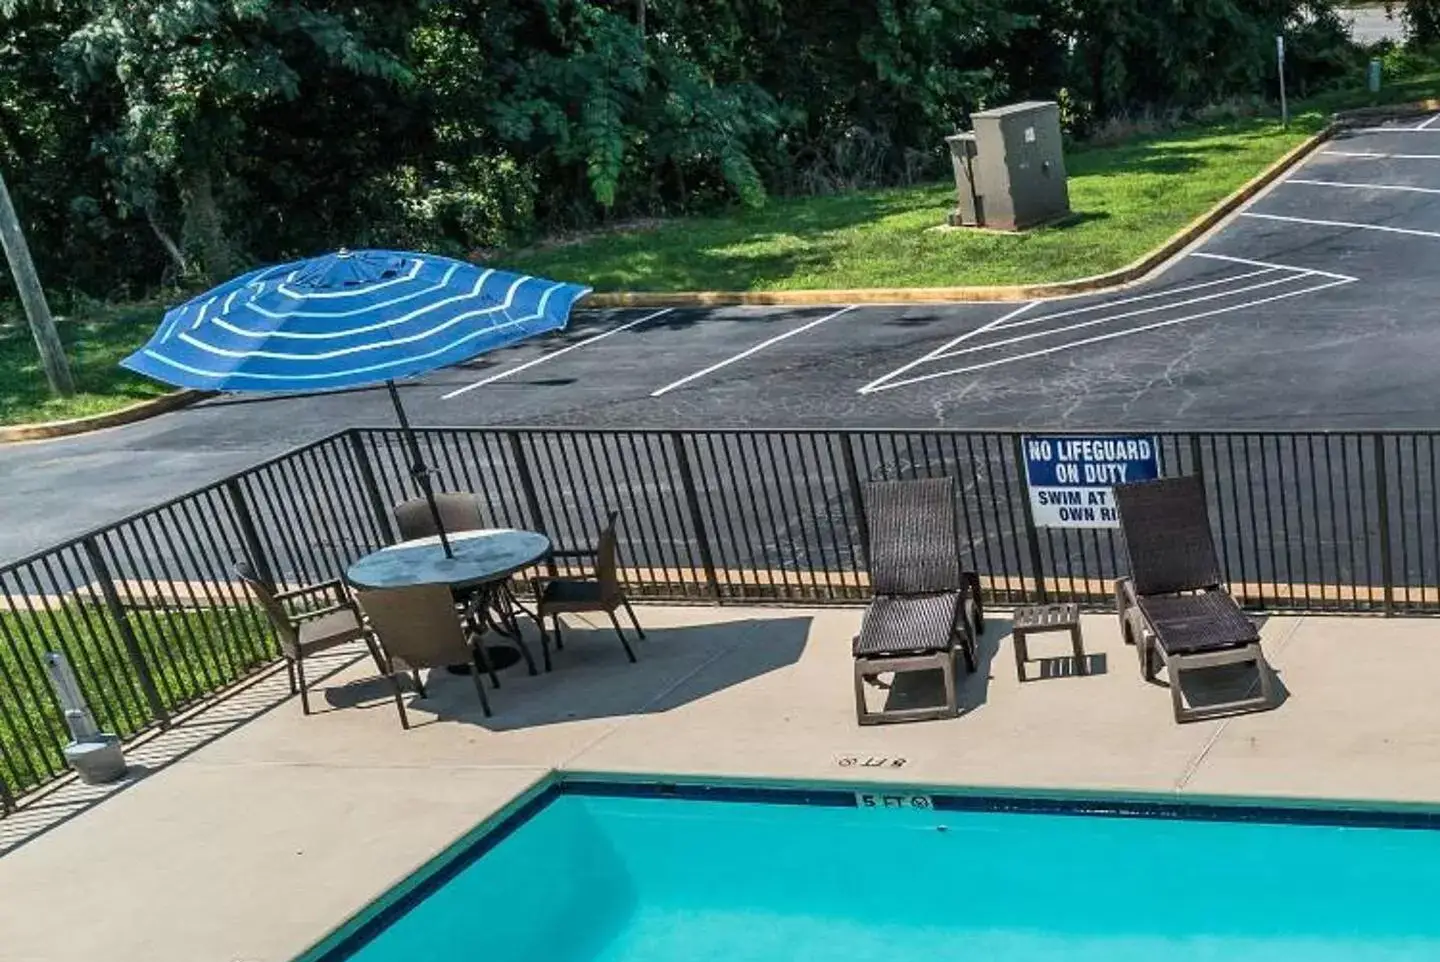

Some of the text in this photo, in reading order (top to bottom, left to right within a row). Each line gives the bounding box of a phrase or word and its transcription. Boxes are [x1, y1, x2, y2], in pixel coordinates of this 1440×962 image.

[1028, 439, 1151, 461] NO LIFEGUARD
[1055, 463, 1128, 483] ON DUTY
[1038, 491, 1106, 505] SWIM AT
[1059, 507, 1095, 521] OWN
[859, 758, 888, 767] FT
[862, 794, 905, 808] 5 FT
